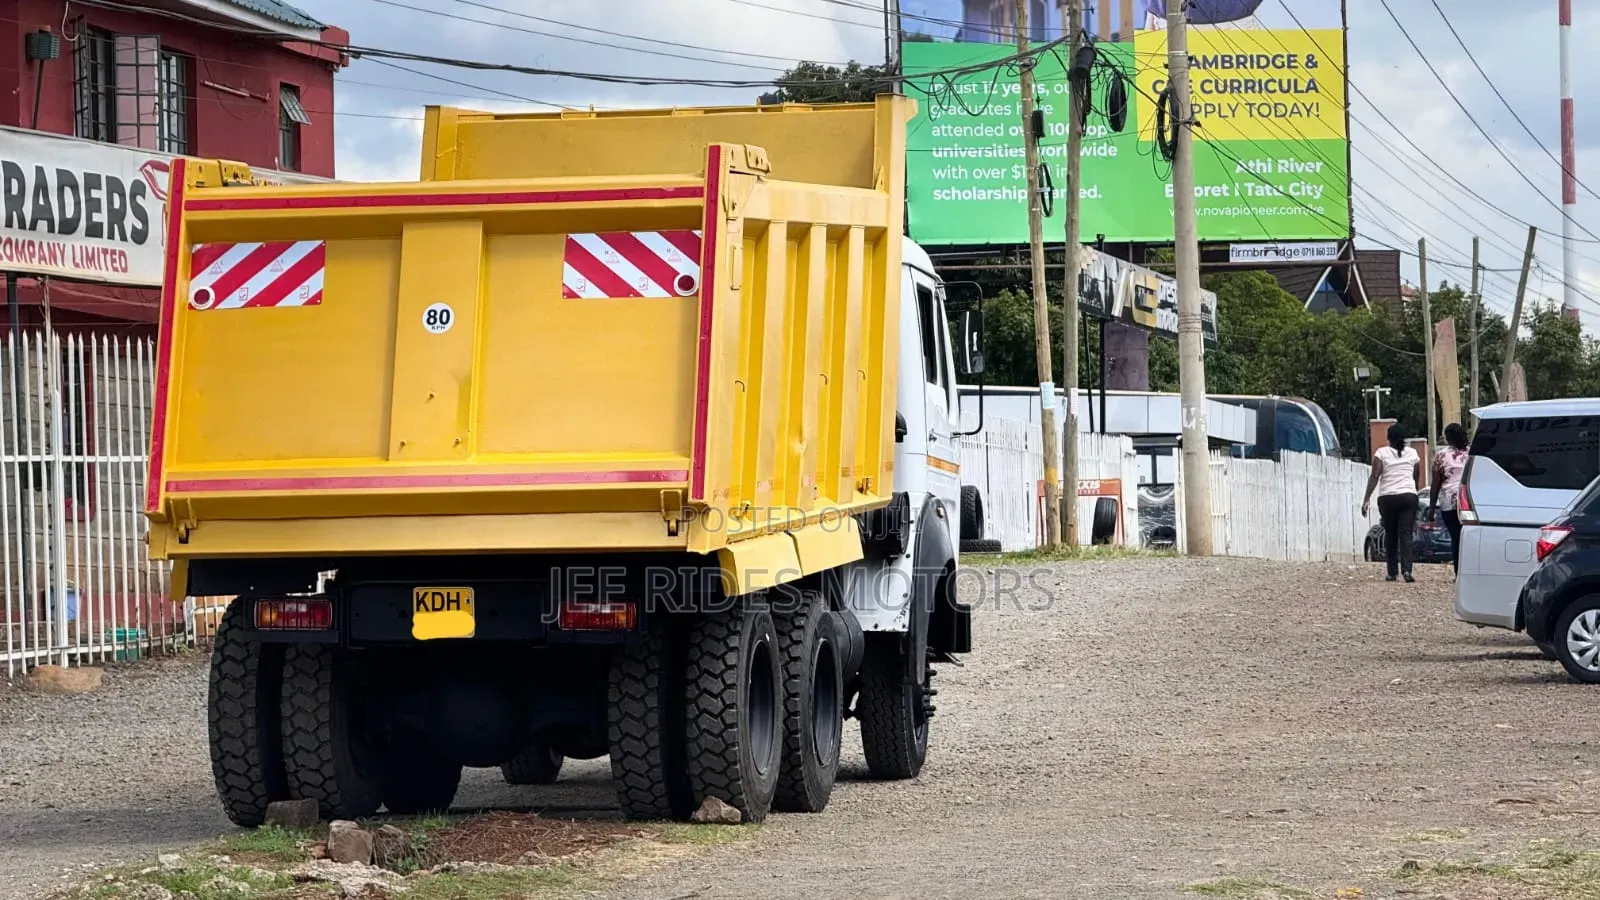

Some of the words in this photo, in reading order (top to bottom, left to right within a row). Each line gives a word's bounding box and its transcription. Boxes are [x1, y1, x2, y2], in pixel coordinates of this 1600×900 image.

[1304, 54, 1319, 70] &
[1200, 78, 1320, 95] CURRICULA
[1244, 102, 1321, 119] TODAY!
[931, 122, 1004, 137] attended
[932, 144, 1026, 158] universities
[932, 164, 969, 179] with
[972, 167, 1007, 179] over
[1235, 159, 1272, 174] Athi
[1277, 159, 1323, 174] River
[1244, 183, 1284, 198] Tatu
[1288, 182, 1324, 199] City
[72, 244, 129, 273] LIMITED
[426, 309, 450, 325] 80
[415, 591, 461, 612] KDH
